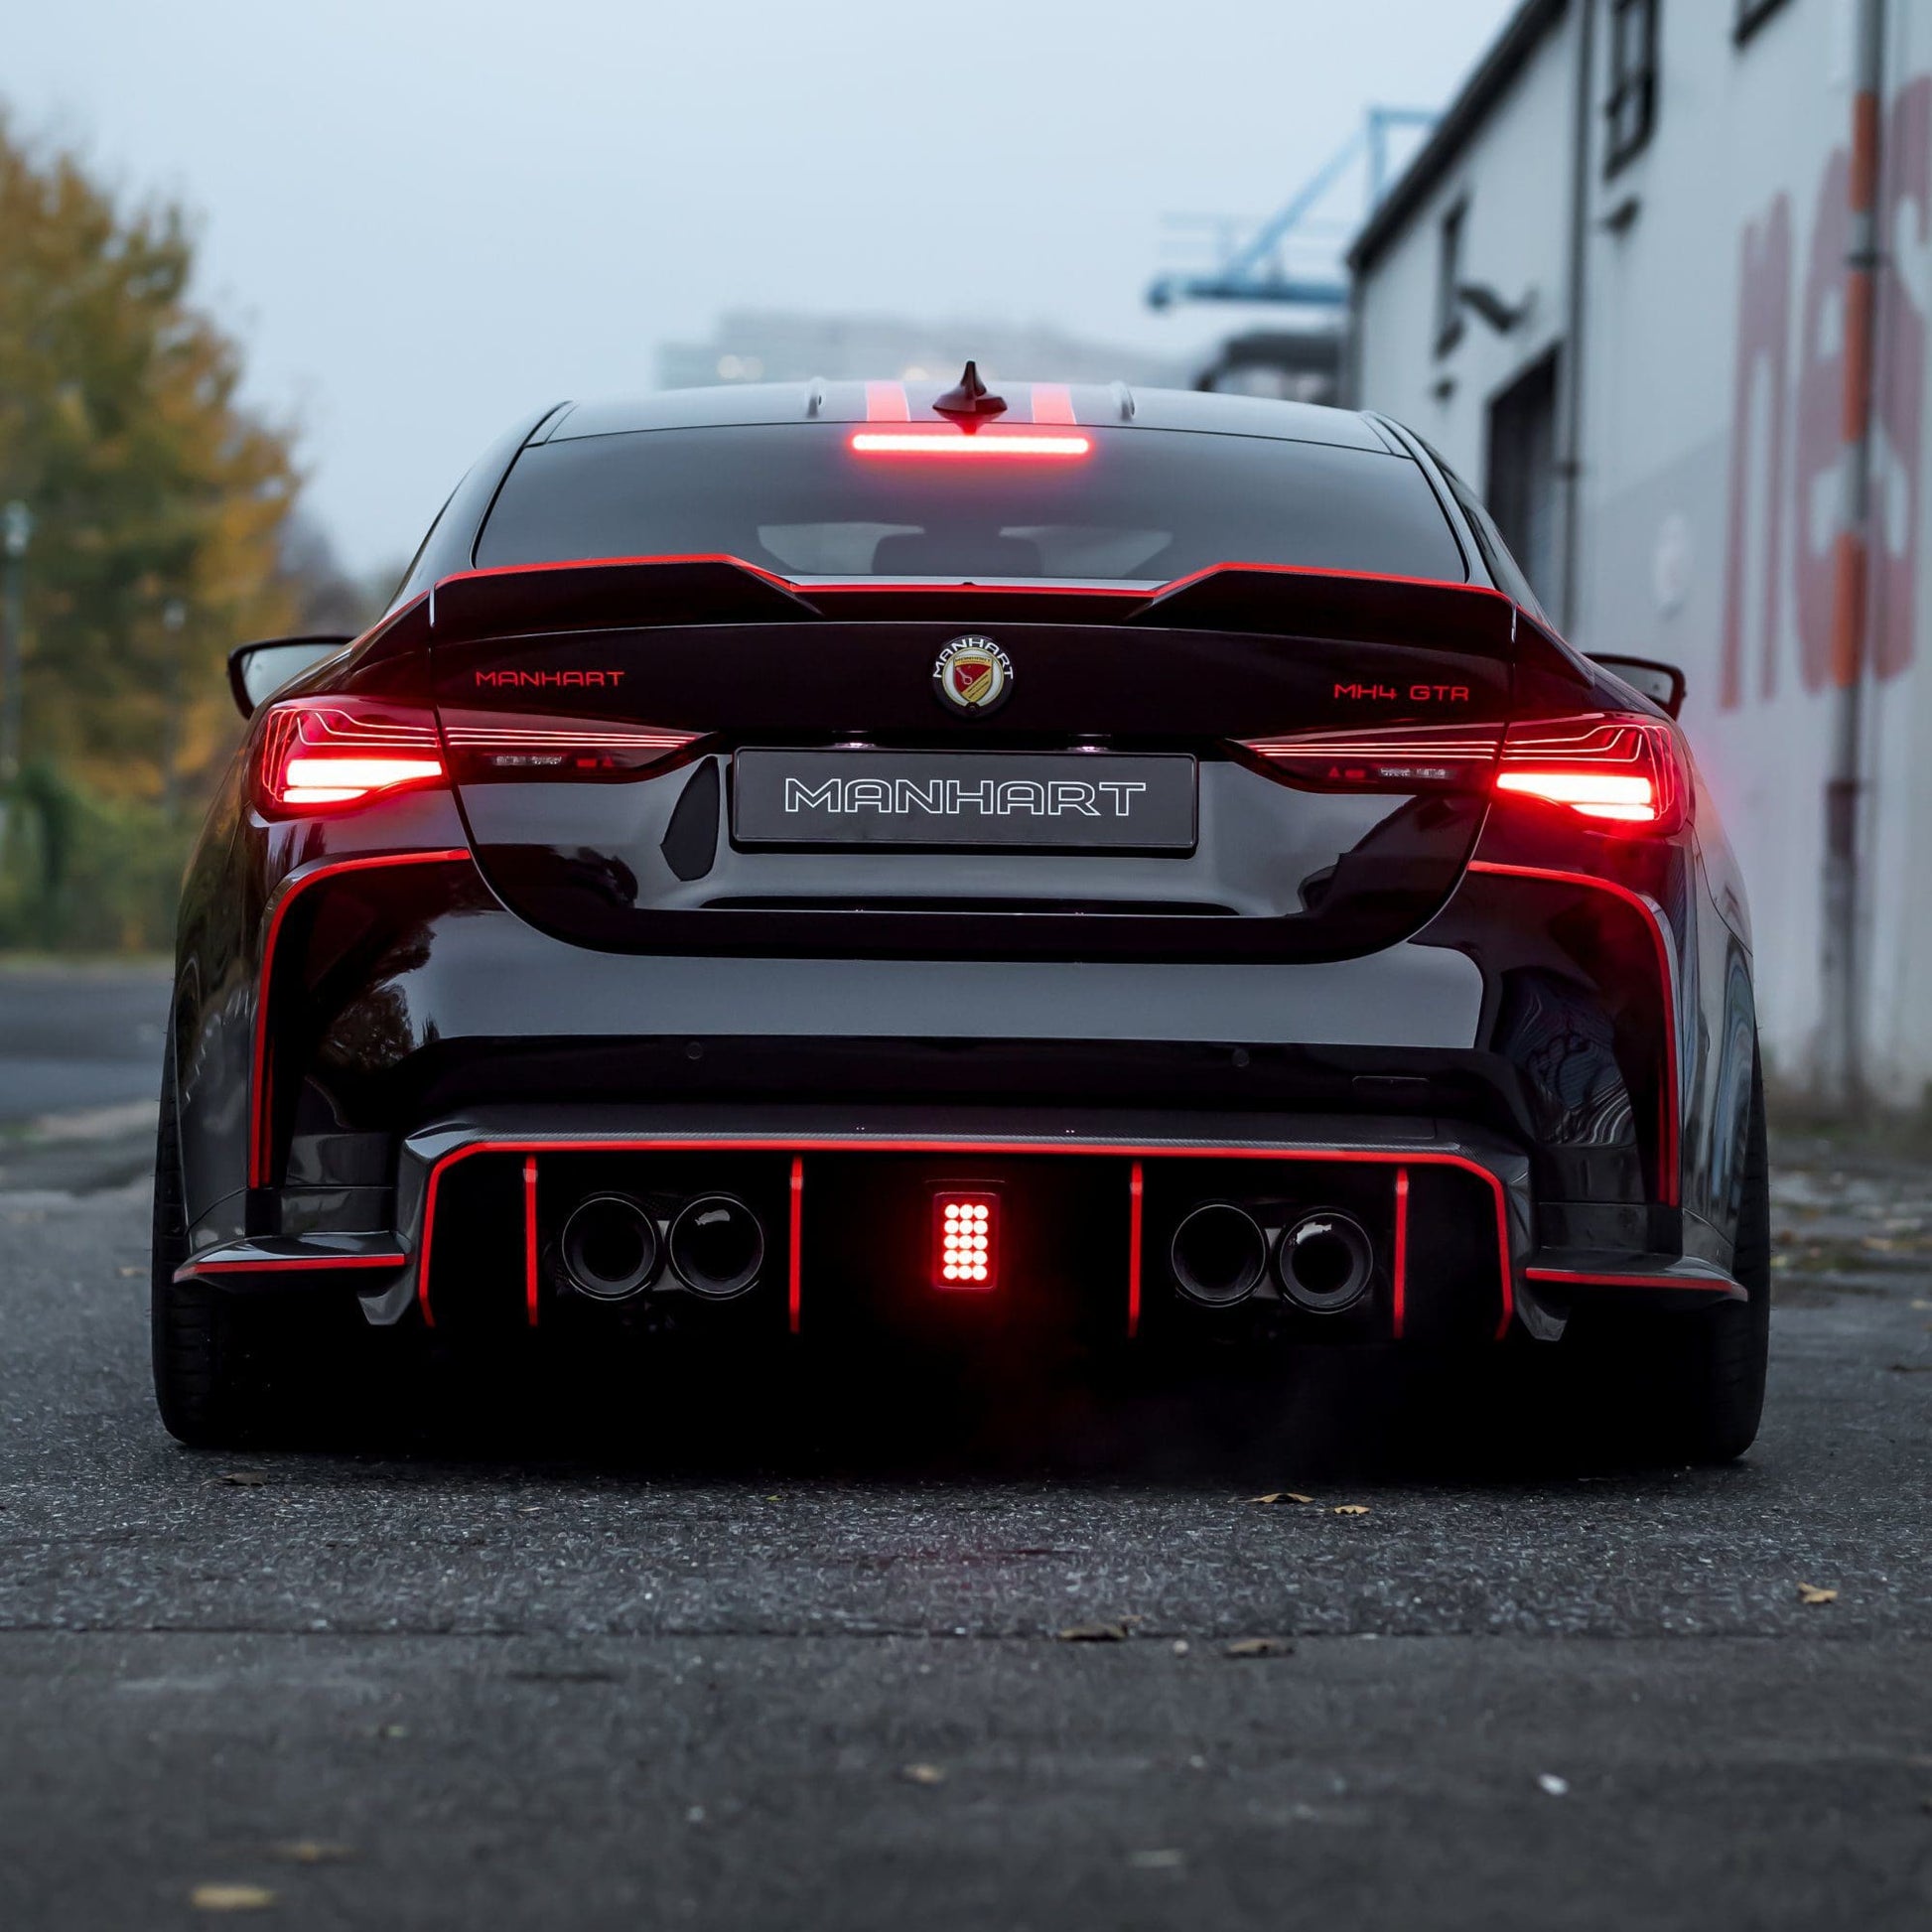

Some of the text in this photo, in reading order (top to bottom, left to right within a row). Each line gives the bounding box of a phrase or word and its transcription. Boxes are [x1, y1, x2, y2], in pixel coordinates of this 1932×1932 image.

[932, 637, 1014, 680] MANHART
[475, 670, 625, 688] MANHART
[1333, 683, 1469, 701] MH4 GTR
[784, 777, 1147, 817] MANHART
